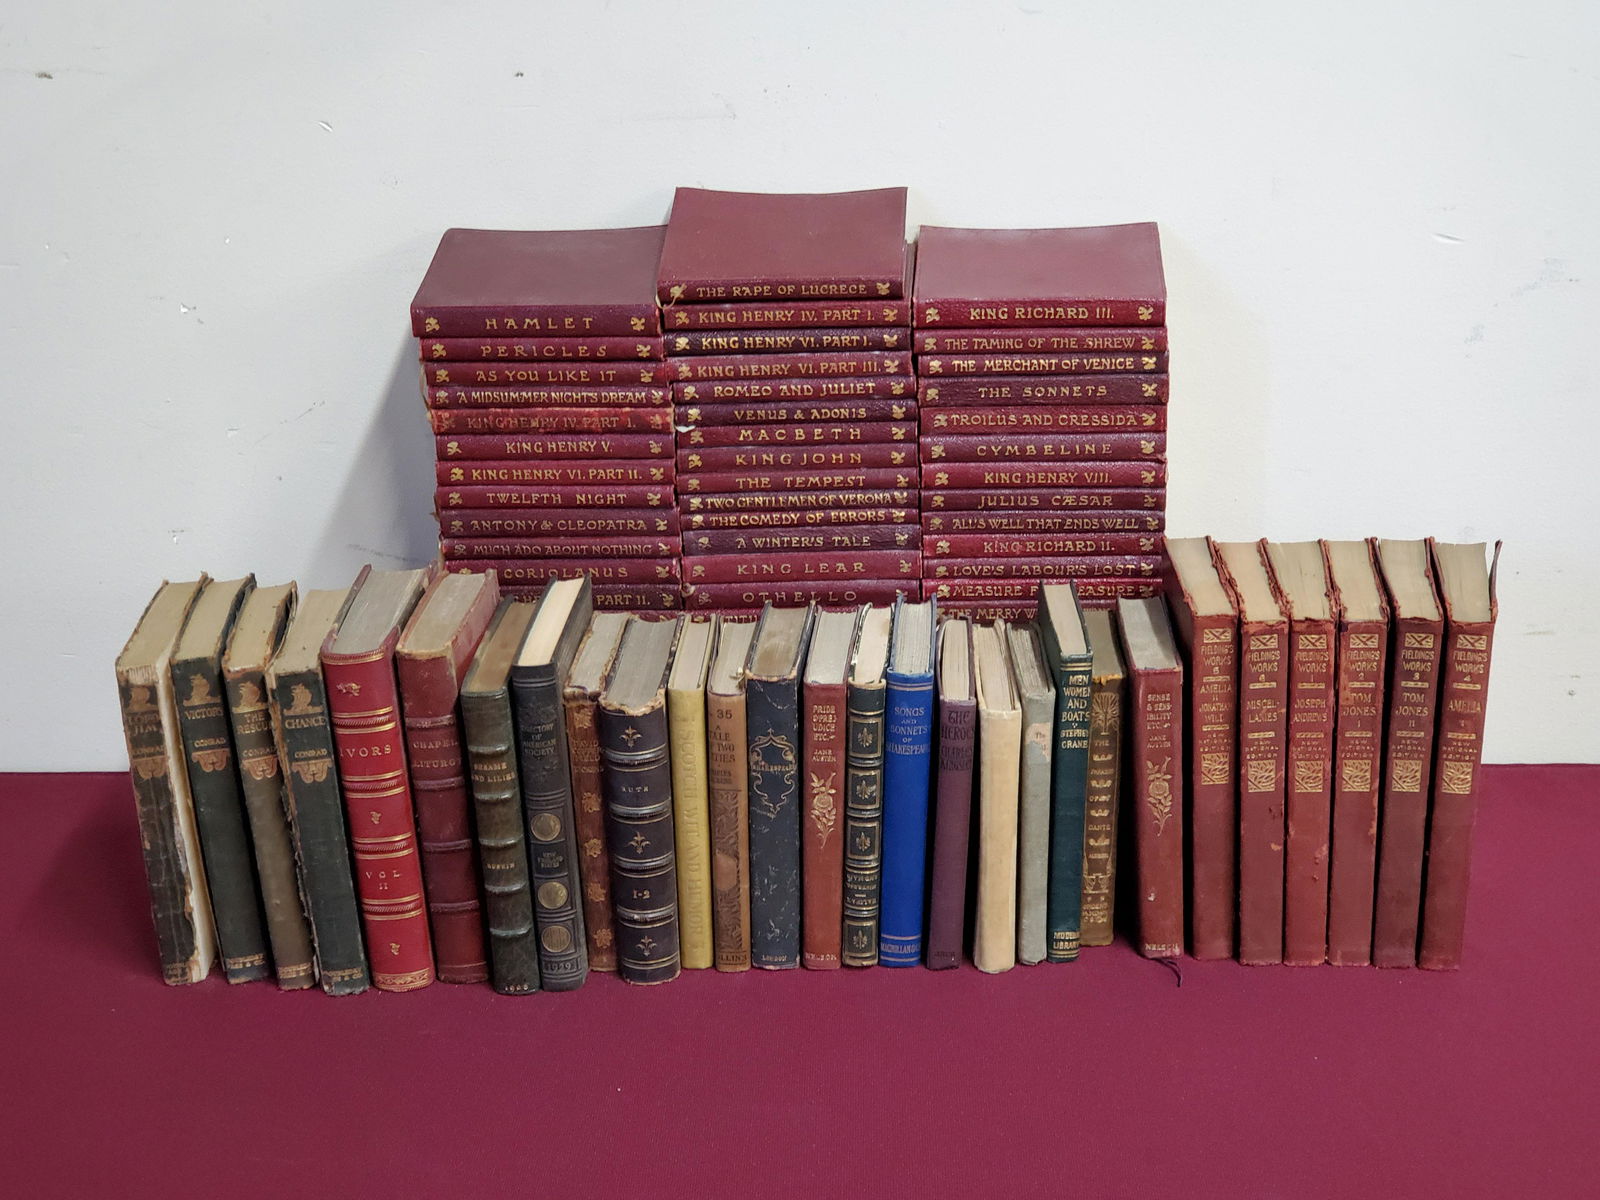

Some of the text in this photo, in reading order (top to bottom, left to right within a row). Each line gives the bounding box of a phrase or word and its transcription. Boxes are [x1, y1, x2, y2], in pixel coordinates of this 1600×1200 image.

[697, 284, 868, 297] THE RAPE OF LUCRECE
[699, 312, 737, 323] KING
[742, 311, 794, 322] HENRY
[823, 310, 861, 321] PART
[969, 308, 1009, 320] KING
[1014, 308, 1089, 319] RICHARD
[485, 317, 594, 330] HAMLET
[702, 337, 739, 350] KING
[744, 337, 795, 349] HENRY
[823, 336, 864, 346] PART
[944, 337, 1136, 350] THE TAMING OF THE SHREW
[480, 346, 609, 358] PERICLES
[698, 366, 735, 378] KING
[740, 364, 792, 376] HENRY
[820, 363, 858, 374] PART
[951, 358, 1135, 371] THE MERCHANT OF VENICE
[476, 370, 617, 381] AS YOU LIKE IT
[714, 383, 876, 398] ROMEO AND JULIET
[978, 385, 1108, 398] THE SONNETS
[471, 391, 548, 403] MIDSUMMER
[601, 391, 647, 404] DREAM
[734, 408, 867, 421] VENUS & ADONIS
[950, 414, 1138, 426] TROILUS AND CRESSIDA
[467, 417, 505, 430] KING
[583, 417, 620, 429] PART
[739, 429, 861, 441] MACBETH
[506, 442, 613, 454] KING HENRY V.
[977, 443, 1113, 456] CYMBELINE
[736, 454, 862, 465] KING JOHN
[471, 470, 508, 481] KING
[513, 470, 562, 481] HENRY
[567, 470, 586, 481] VI.
[589, 469, 624, 481] PART
[984, 472, 1021, 484] KING
[1026, 472, 1078, 483] HENRY
[736, 476, 866, 489] THE TEMPEST
[486, 493, 627, 504] TWELFTH NIGHT
[705, 494, 892, 509] TWO GENTLEMEN OF VERONA
[978, 495, 1040, 509] JULIUS
[710, 511, 886, 527] THE COMEDY OF ERRORS
[989, 518, 1026, 530] WELL
[1028, 518, 1062, 530] THAT
[1064, 518, 1100, 530] ENDS
[1102, 518, 1140, 529] WELL
[470, 520, 648, 532] ANTONY & CLEOPATRA
[736, 537, 747, 548] A
[832, 536, 871, 547] TALE
[984, 542, 1023, 553] KING
[1026, 541, 1096, 553] RICHARD
[474, 544, 652, 556] MUCH ADO ABOUT NOTHING
[737, 563, 867, 575] KING LEAR
[953, 565, 1005, 577] LOVE'S
[1094, 565, 1135, 576] LOST
[742, 591, 857, 602] OTHELLO
[953, 586, 1023, 597] MEASURE
[1078, 585, 1135, 596] EASURE
[596, 594, 632, 606] PART
[949, 608, 972, 618] THE
[975, 608, 1021, 620] MERRY
[1205, 656, 1232, 666] WORKS
[1348, 661, 1378, 672] WORKS
[1402, 661, 1432, 672] WORKS
[1249, 662, 1278, 673] WORKS
[1298, 662, 1327, 673] WORKS
[1455, 662, 1484, 674] WORKS
[1069, 675, 1090, 686] MEN
[1200, 684, 1232, 694] AMELIA
[1067, 698, 1087, 709] AND
[1294, 699, 1326, 709] JOSEPH
[1350, 693, 1372, 704] TOM
[1402, 693, 1425, 704] TOM
[184, 706, 225, 720] VICTORY
[813, 705, 836, 714] PRIDE
[894, 707, 925, 717] SONGS
[1343, 706, 1377, 717] JONES
[1395, 706, 1429, 717] JONES
[1062, 710, 1090, 722] BOATS
[285, 716, 326, 730] CHANCE
[890, 725, 928, 736] SONNETS
[1061, 740, 1089, 749] CRANE
[294, 748, 328, 759] CONRAD
